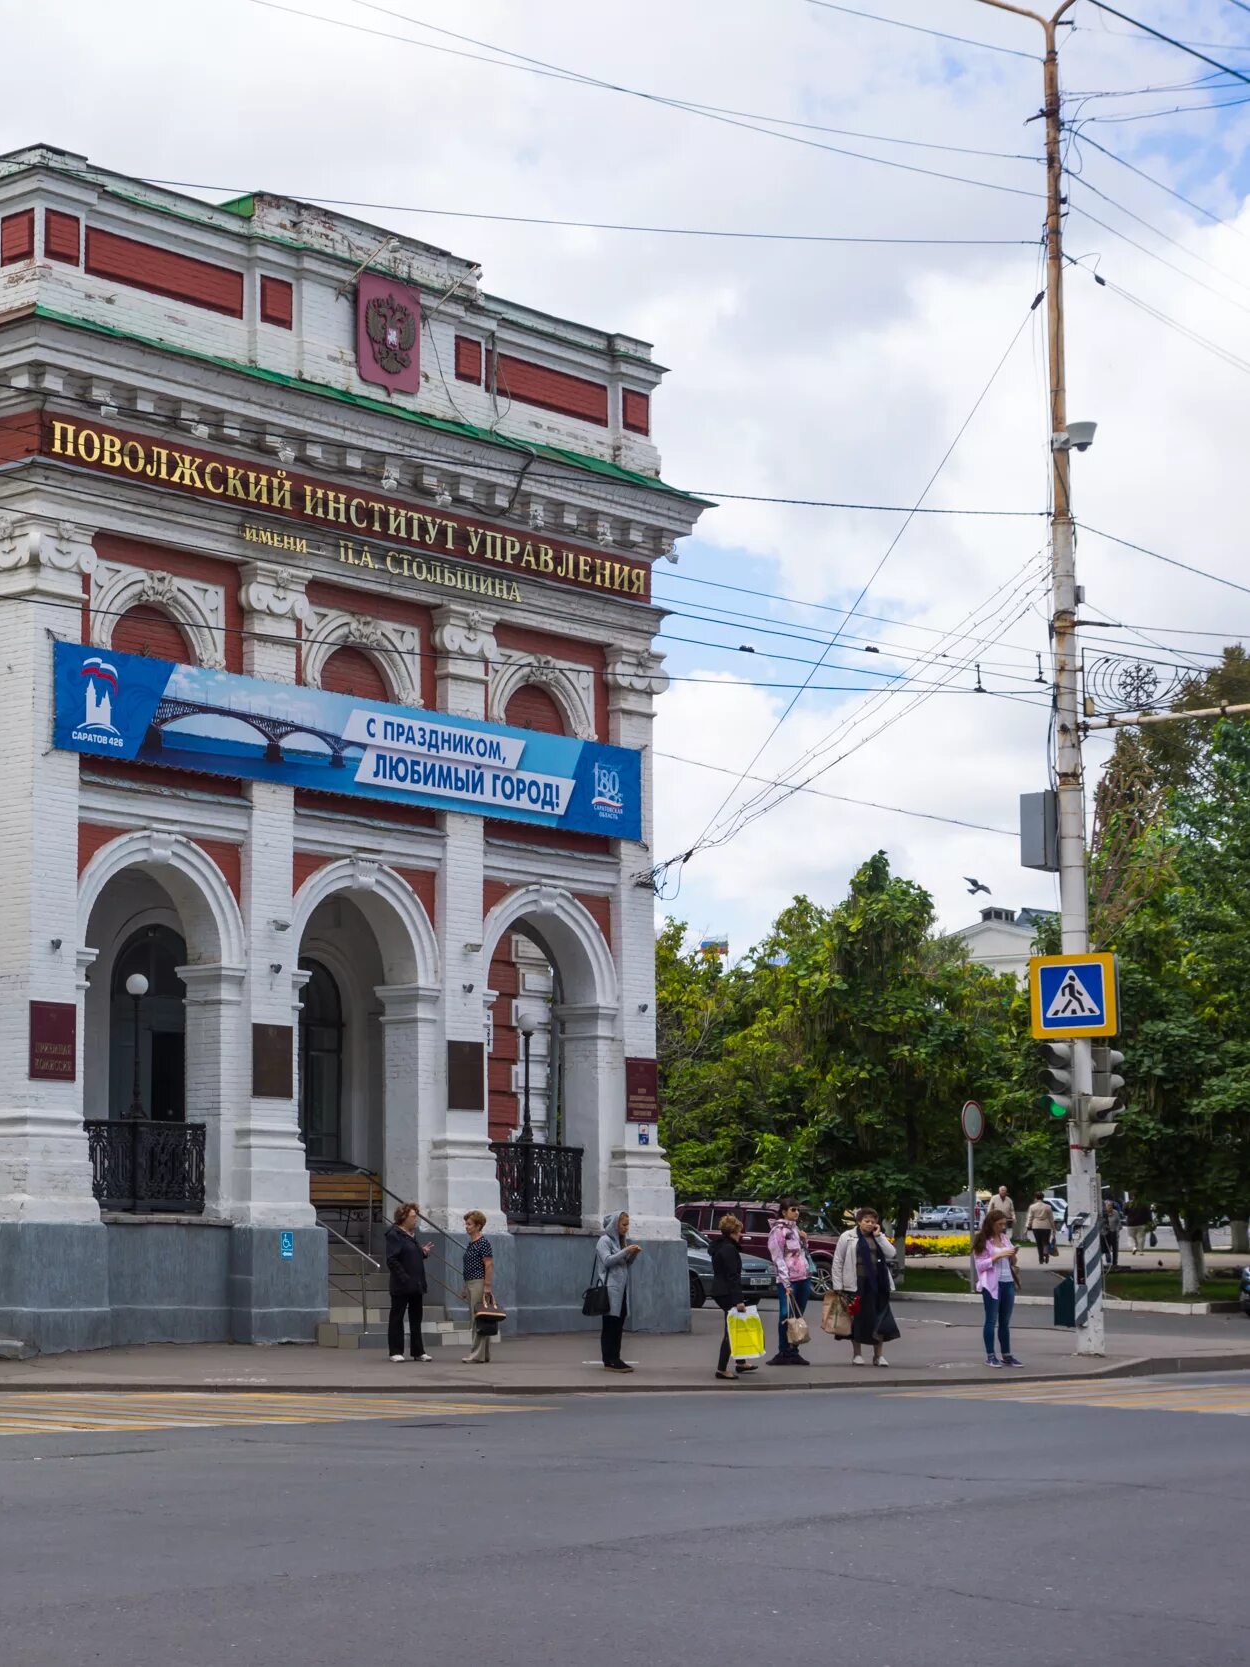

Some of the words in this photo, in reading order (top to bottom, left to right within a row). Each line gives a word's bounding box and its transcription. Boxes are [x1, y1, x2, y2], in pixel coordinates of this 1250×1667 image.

[51, 420, 293, 511] ПОВОЛЖСКИЙ
[303, 484, 458, 550] ИНСТИТУТ
[466, 525, 647, 595] УПРАВЛЕНИЯ
[244, 524, 308, 554] ИМЕНИ
[338, 540, 379, 570] П.А.
[386, 550, 523, 603] СТОЛЫПИНА
[71, 730, 108, 745] САРАТОВ
[108, 737, 124, 748] 426
[366, 717, 377, 738] С
[383, 720, 507, 764] ПРАЗДНИКОМ,
[373, 753, 485, 795] ЛЮБИМЫЙ
[492, 773, 561, 812] ГОРОД!
